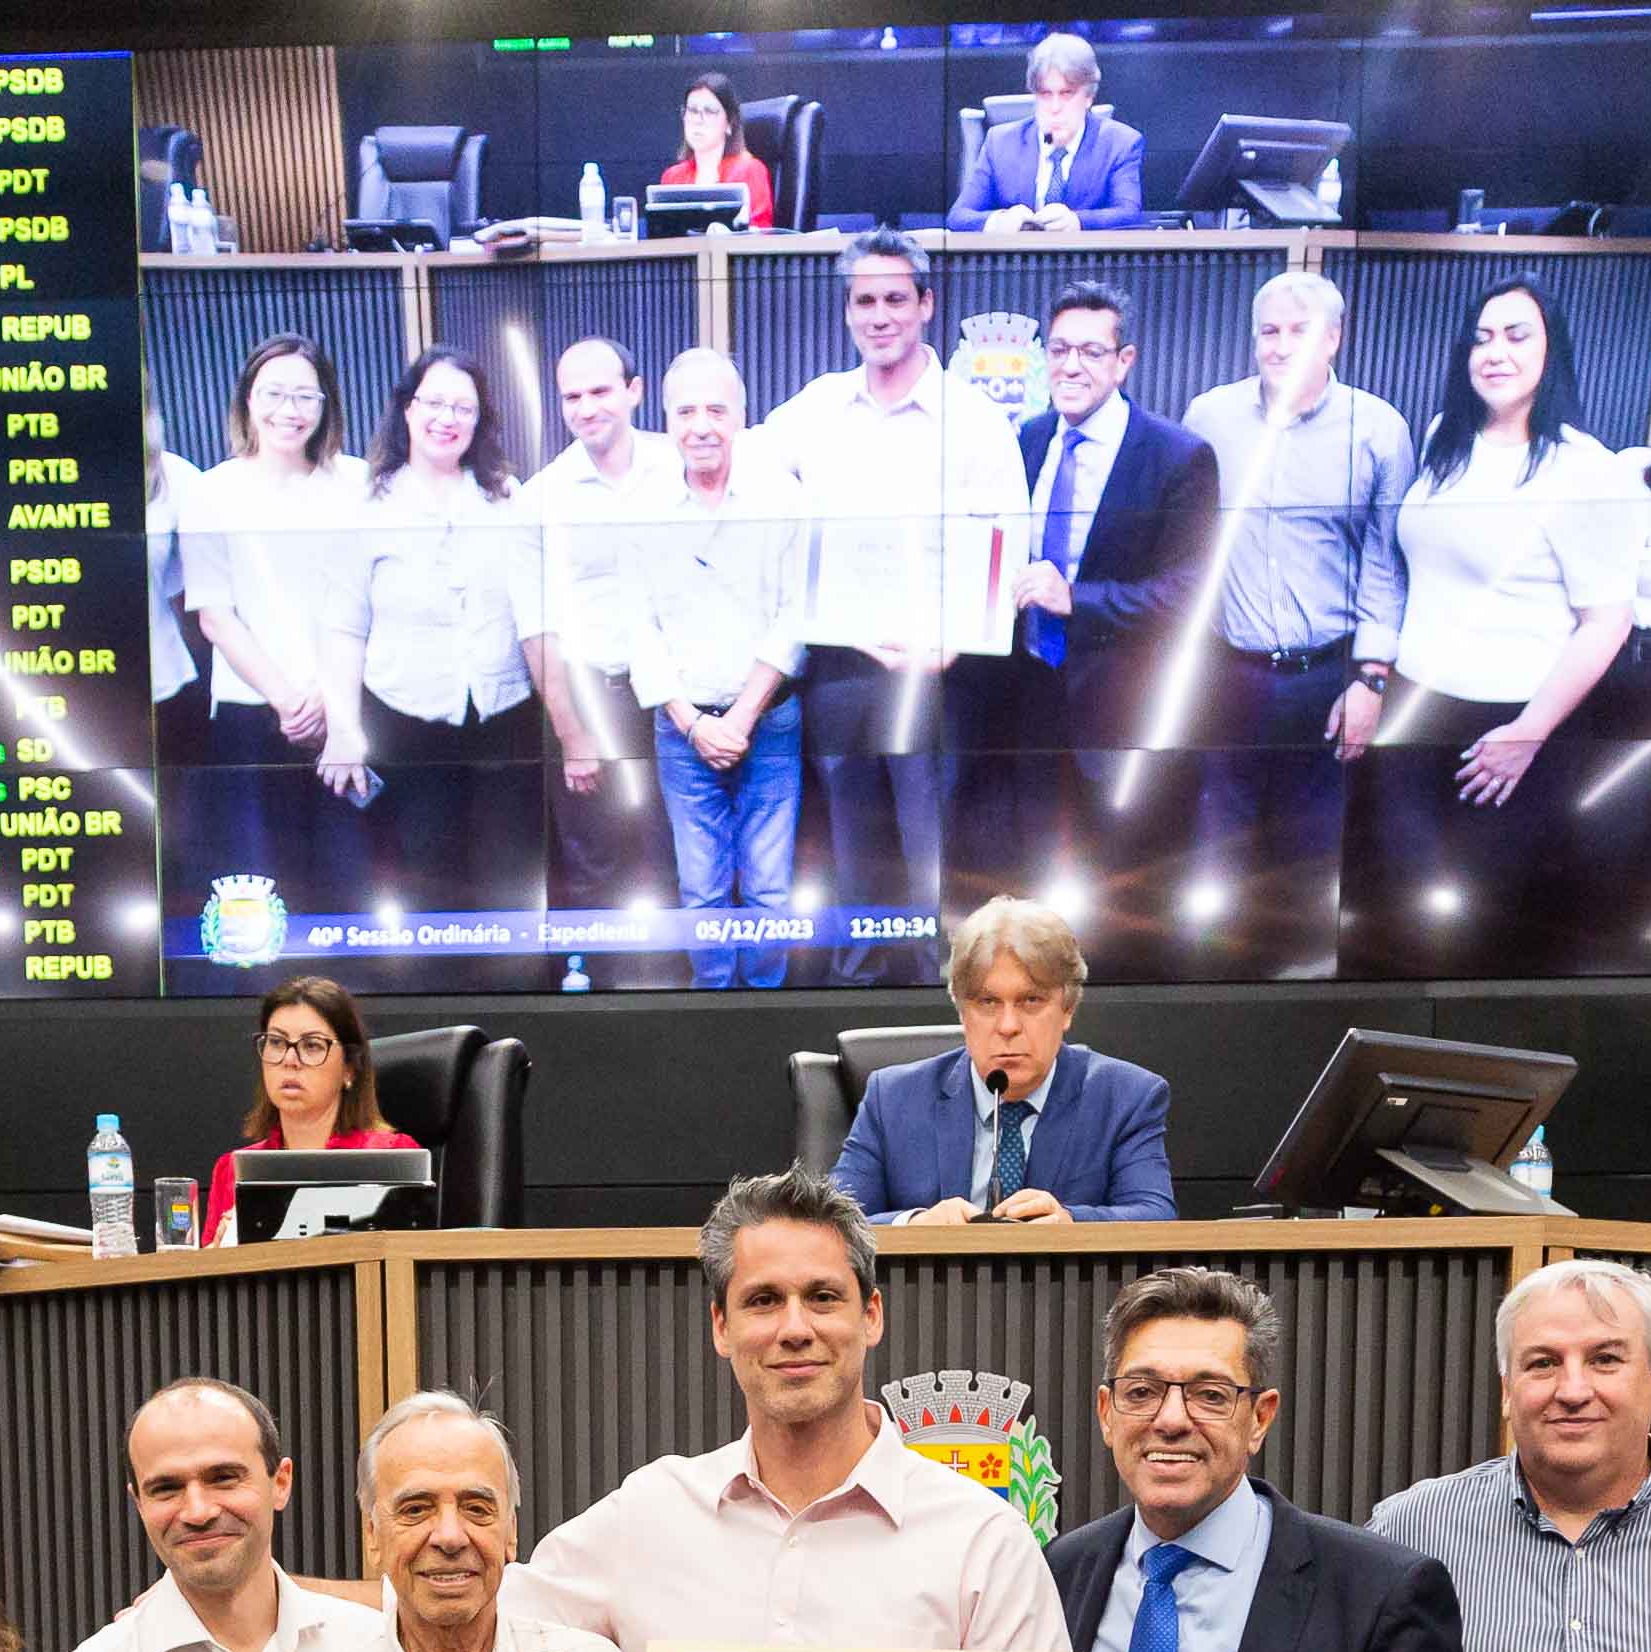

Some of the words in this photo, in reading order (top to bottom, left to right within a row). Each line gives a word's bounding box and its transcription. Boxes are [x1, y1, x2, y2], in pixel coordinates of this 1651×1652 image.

[0, 265, 35, 290] PL
[2, 315, 91, 341] REPUB
[70, 365, 107, 391] BR
[7, 413, 59, 438] PTB
[9, 458, 79, 484] PRTB
[8, 503, 111, 528] AVANTE
[10, 558, 81, 584] PSDB
[12, 605, 65, 629] PDT
[79, 649, 116, 673] BR
[16, 738, 53, 763] SD
[18, 777, 71, 801] PSC
[0, 807, 80, 837] UNIÃO
[85, 811, 122, 836] BR
[21, 848, 73, 872] PDT
[23, 884, 74, 908] PDT
[25, 920, 75, 944] PTB
[346, 926, 413, 946] Sessão
[417, 924, 511, 945] Ordinária
[695, 917, 814, 944] 05/12/2023
[850, 916, 937, 939] 12:19:34
[25, 955, 112, 980] REPUB
